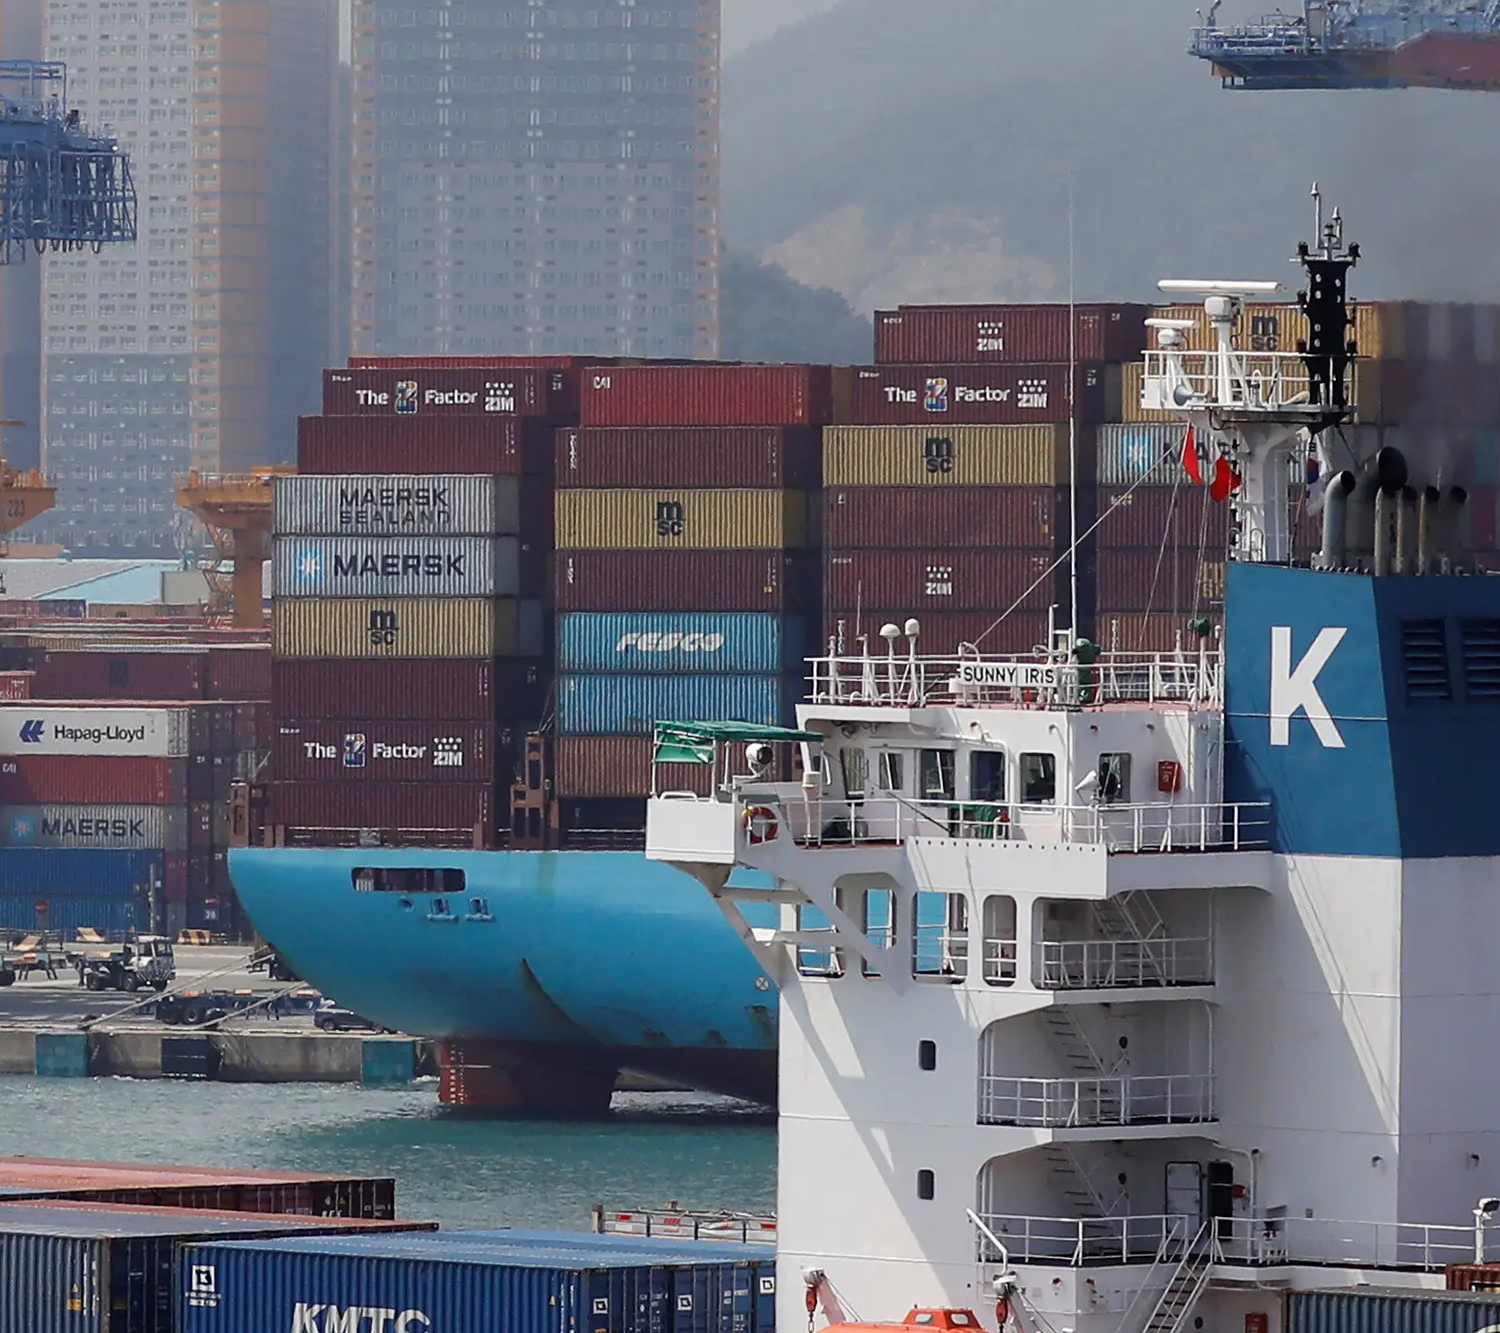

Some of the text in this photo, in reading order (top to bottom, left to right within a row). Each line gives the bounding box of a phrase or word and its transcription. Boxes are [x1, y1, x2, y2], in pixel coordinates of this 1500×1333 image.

[356, 389, 479, 405] The Factor
[884, 386, 1011, 402] The Factor
[1017, 392, 1048, 408] ZIM
[484, 397, 514, 412] ZIM
[340, 488, 449, 507] MAERSK
[340, 510, 450, 525] SEALAND
[333, 554, 465, 577] MAERSK
[963, 667, 1055, 684] SUNNY IRIS
[1268, 626, 1349, 748] K
[53, 725, 145, 744] Hapag-Lloyd
[304, 742, 427, 759] The Factor
[433, 751, 463, 766] ZIM
[41, 819, 145, 838] MAERSK
